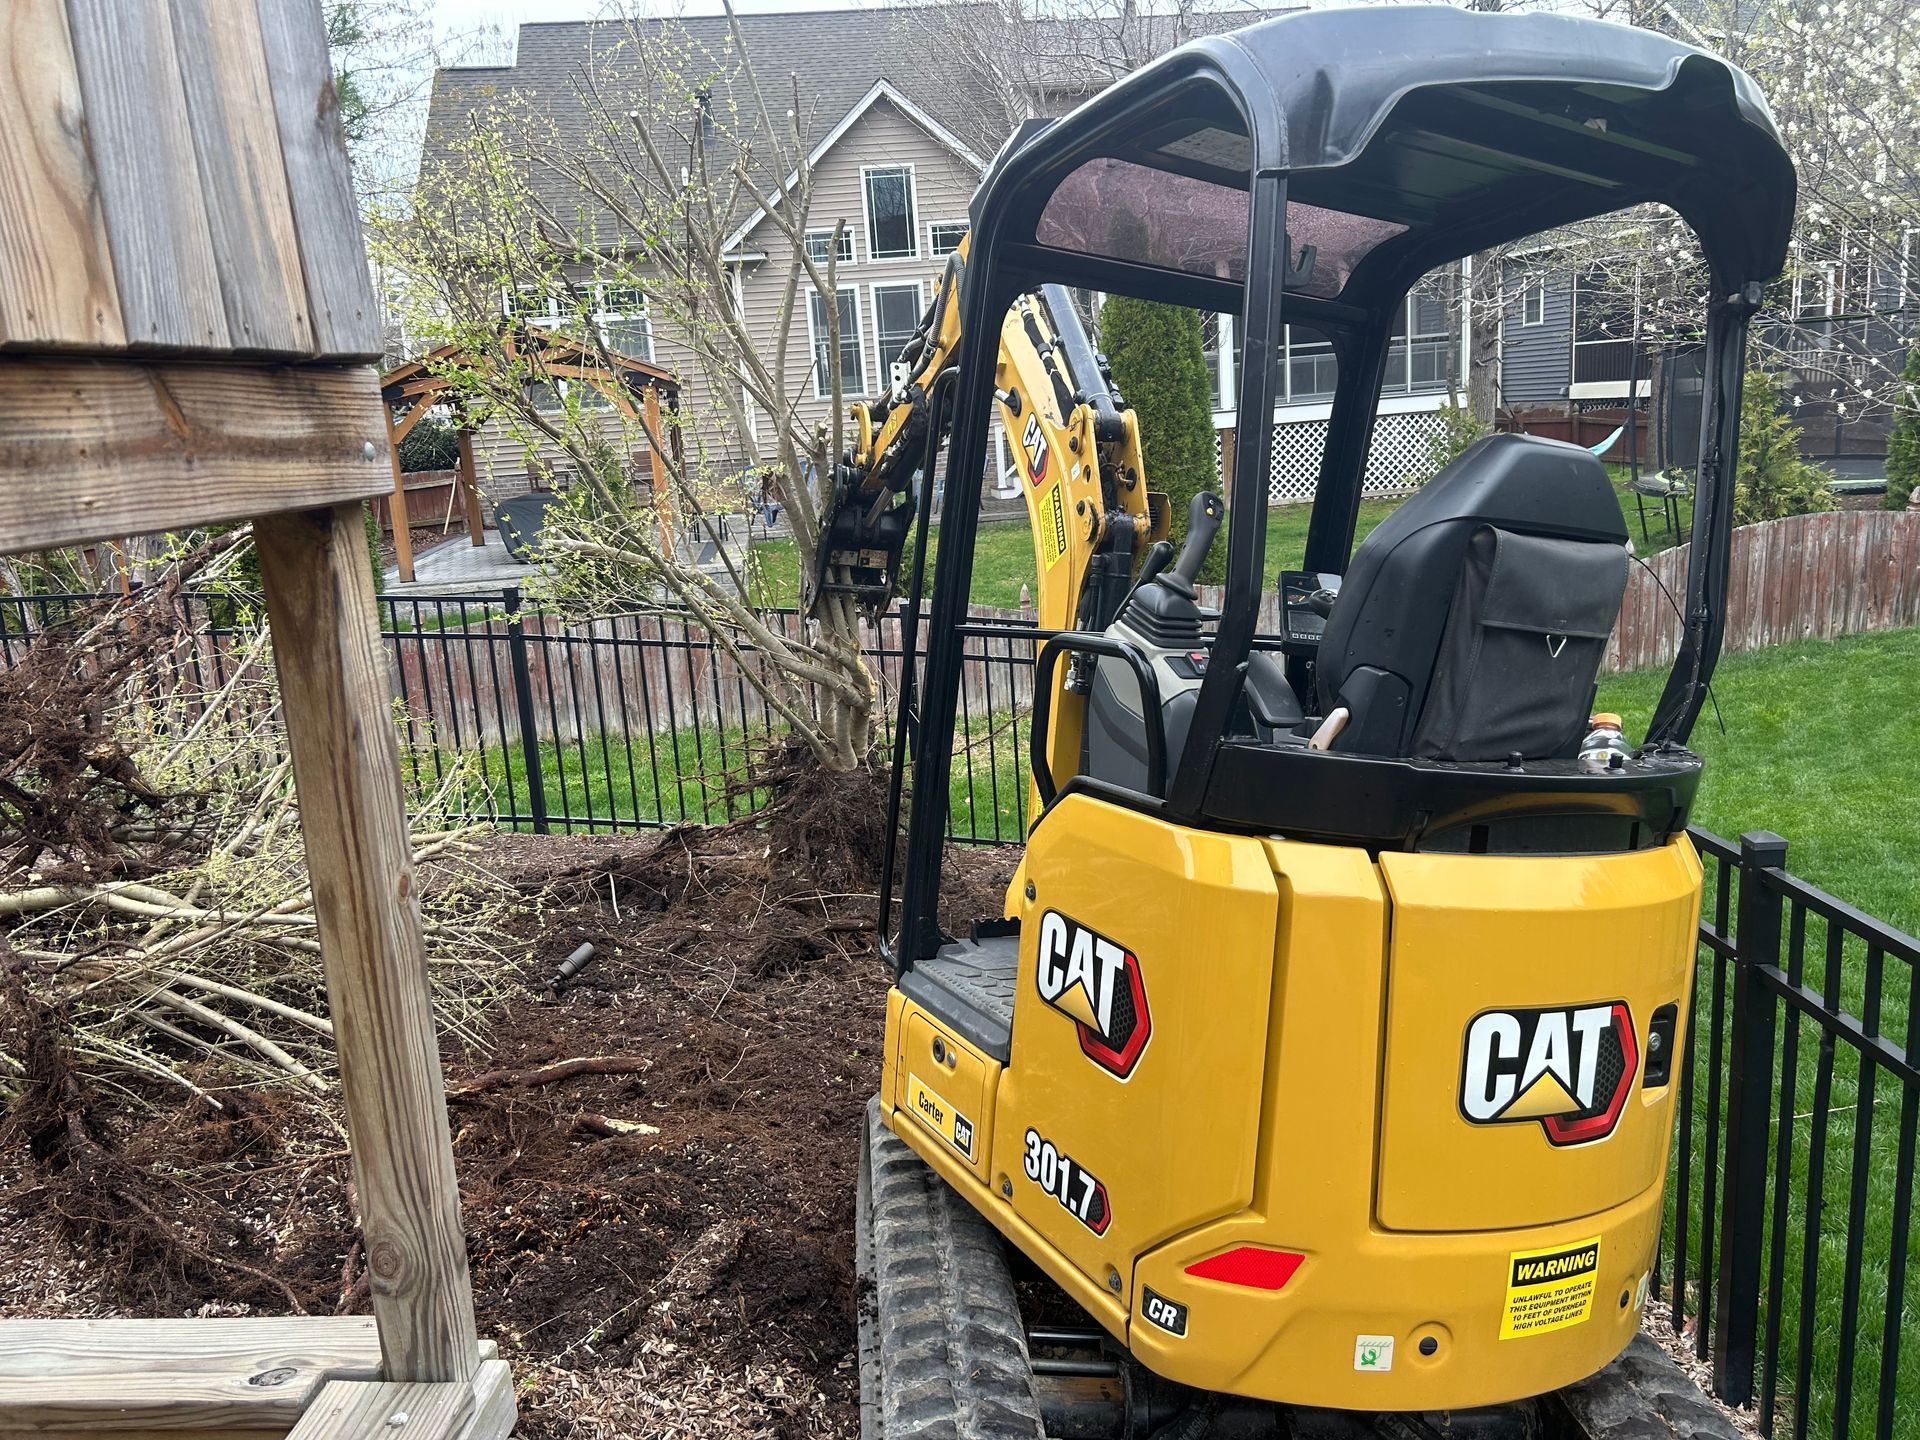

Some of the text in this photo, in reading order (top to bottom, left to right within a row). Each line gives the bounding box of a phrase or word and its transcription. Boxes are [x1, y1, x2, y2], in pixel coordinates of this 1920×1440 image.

[1022, 413, 1047, 471] CAT
[1053, 488, 1065, 551] WARNING
[1038, 912, 1125, 1038] CAT
[1464, 1005, 1613, 1119] CAT
[919, 1090, 971, 1148] Carter CAT
[1025, 1130, 1096, 1221] 301.7
[1517, 1250, 1595, 1281] WARNING
[1149, 1298, 1178, 1328] CR
[1510, 1289, 1592, 1313] THIS EQUIPMENT WITHIN
[1513, 1280, 1592, 1304] UNLAWFUL TO OPERATE
[1513, 1299, 1587, 1322] 10 FEET OF OVERHEAD
[1513, 1308, 1583, 1331] HIGH VOLTAGE LINES
